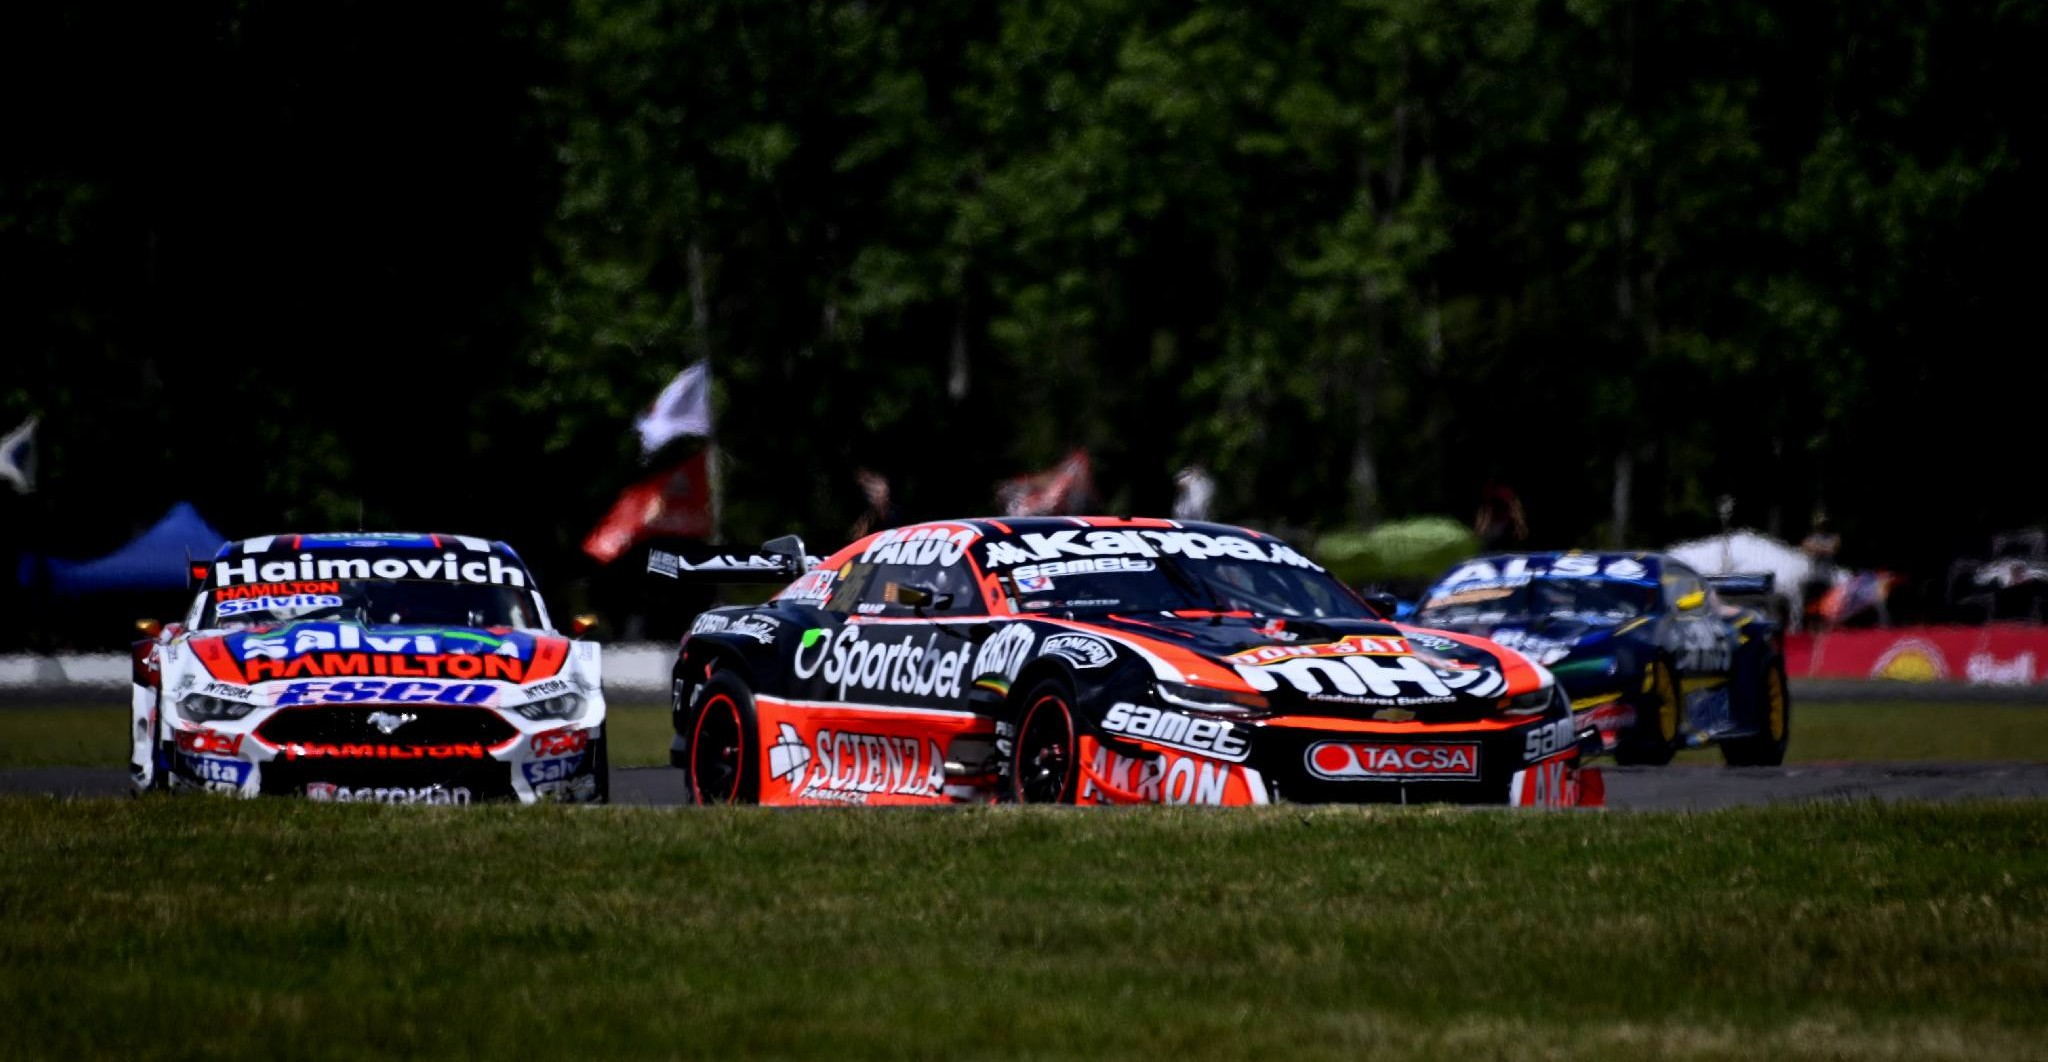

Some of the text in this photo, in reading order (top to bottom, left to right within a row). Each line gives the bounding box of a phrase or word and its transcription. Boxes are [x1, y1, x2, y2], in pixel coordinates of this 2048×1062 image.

[860, 527, 976, 566] PARDO
[1020, 530, 1271, 562] Kappa
[215, 553, 525, 587] Haimovich
[1012, 557, 1156, 580] samet
[215, 580, 339, 601] HAMILTON
[216, 594, 343, 616] Salvita
[245, 653, 524, 684] HAMILTON
[823, 624, 973, 701] Sportsbet
[275, 681, 498, 705] ESCO
[522, 680, 568, 700] INTEGRA
[1101, 701, 1249, 762] samet
[286, 741, 484, 762] HAMILTON
[813, 730, 946, 798] SCIENZA
[1363, 746, 1470, 770] TACSA
[1082, 747, 1229, 805] AKRON
